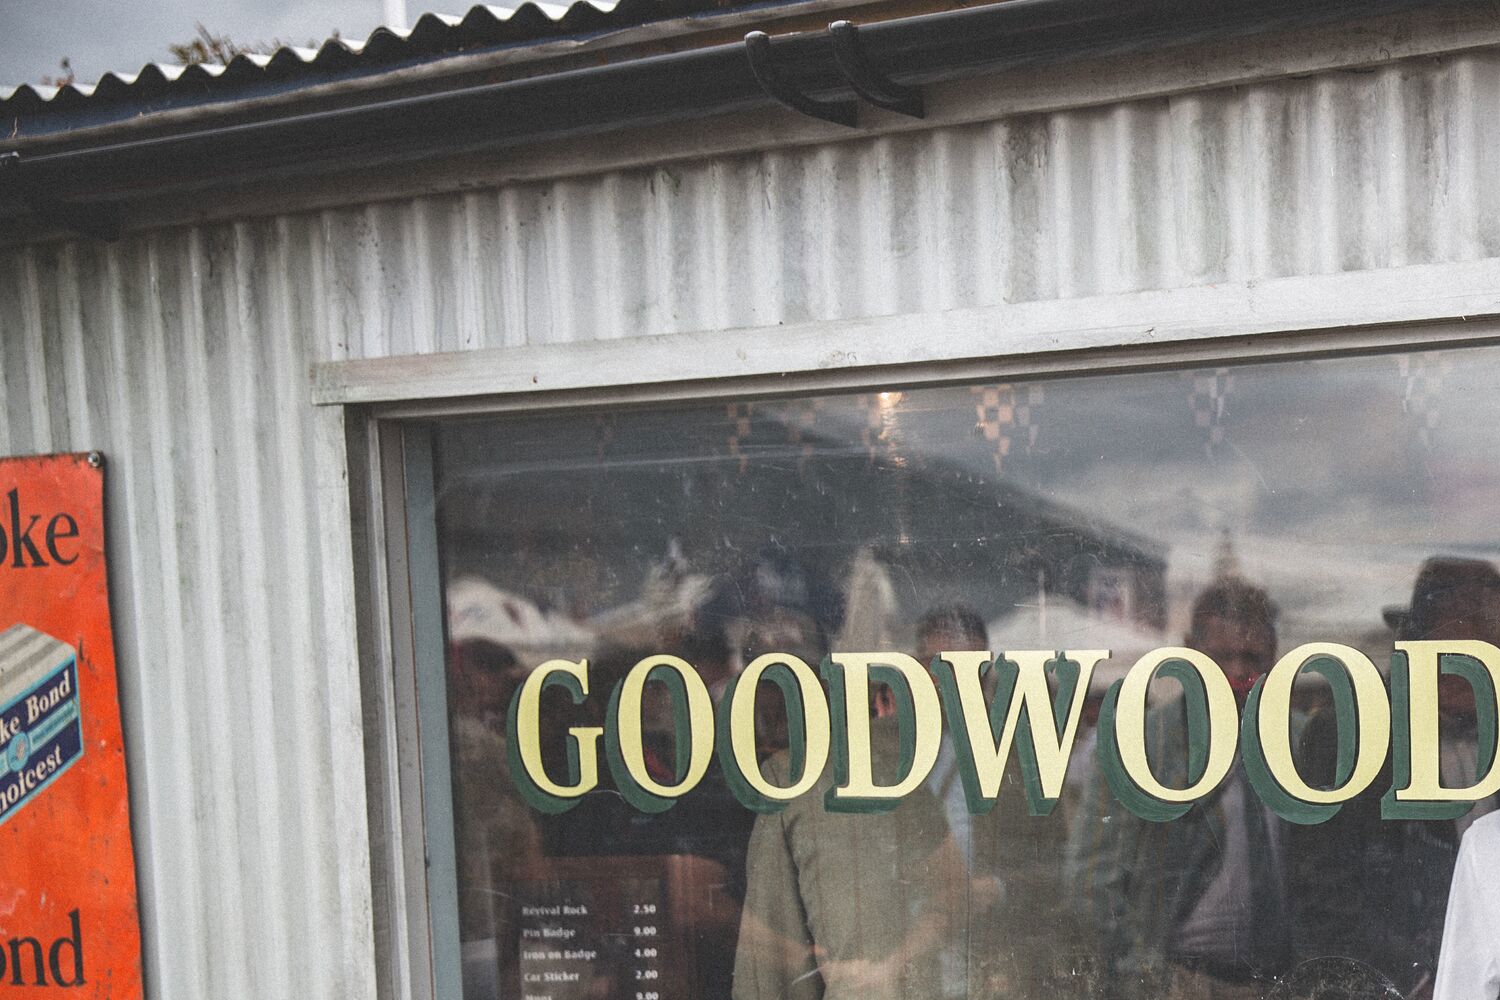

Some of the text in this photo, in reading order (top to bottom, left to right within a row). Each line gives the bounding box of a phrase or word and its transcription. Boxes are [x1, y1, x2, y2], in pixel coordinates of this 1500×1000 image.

[0, 487, 79, 568] ke
[25, 669, 71, 725] Bond
[563, 904, 588, 915] Rock
[633, 904, 657, 914] 2.50
[523, 928, 540, 937] Pin
[542, 927, 576, 939] Badge
[0, 908, 87, 987] ond
[523, 950, 545, 960] Iron
[547, 952, 562, 960] on
[564, 949, 597, 961] Badge
[523, 972, 541, 982] Car
[544, 971, 580, 982] Sticker
